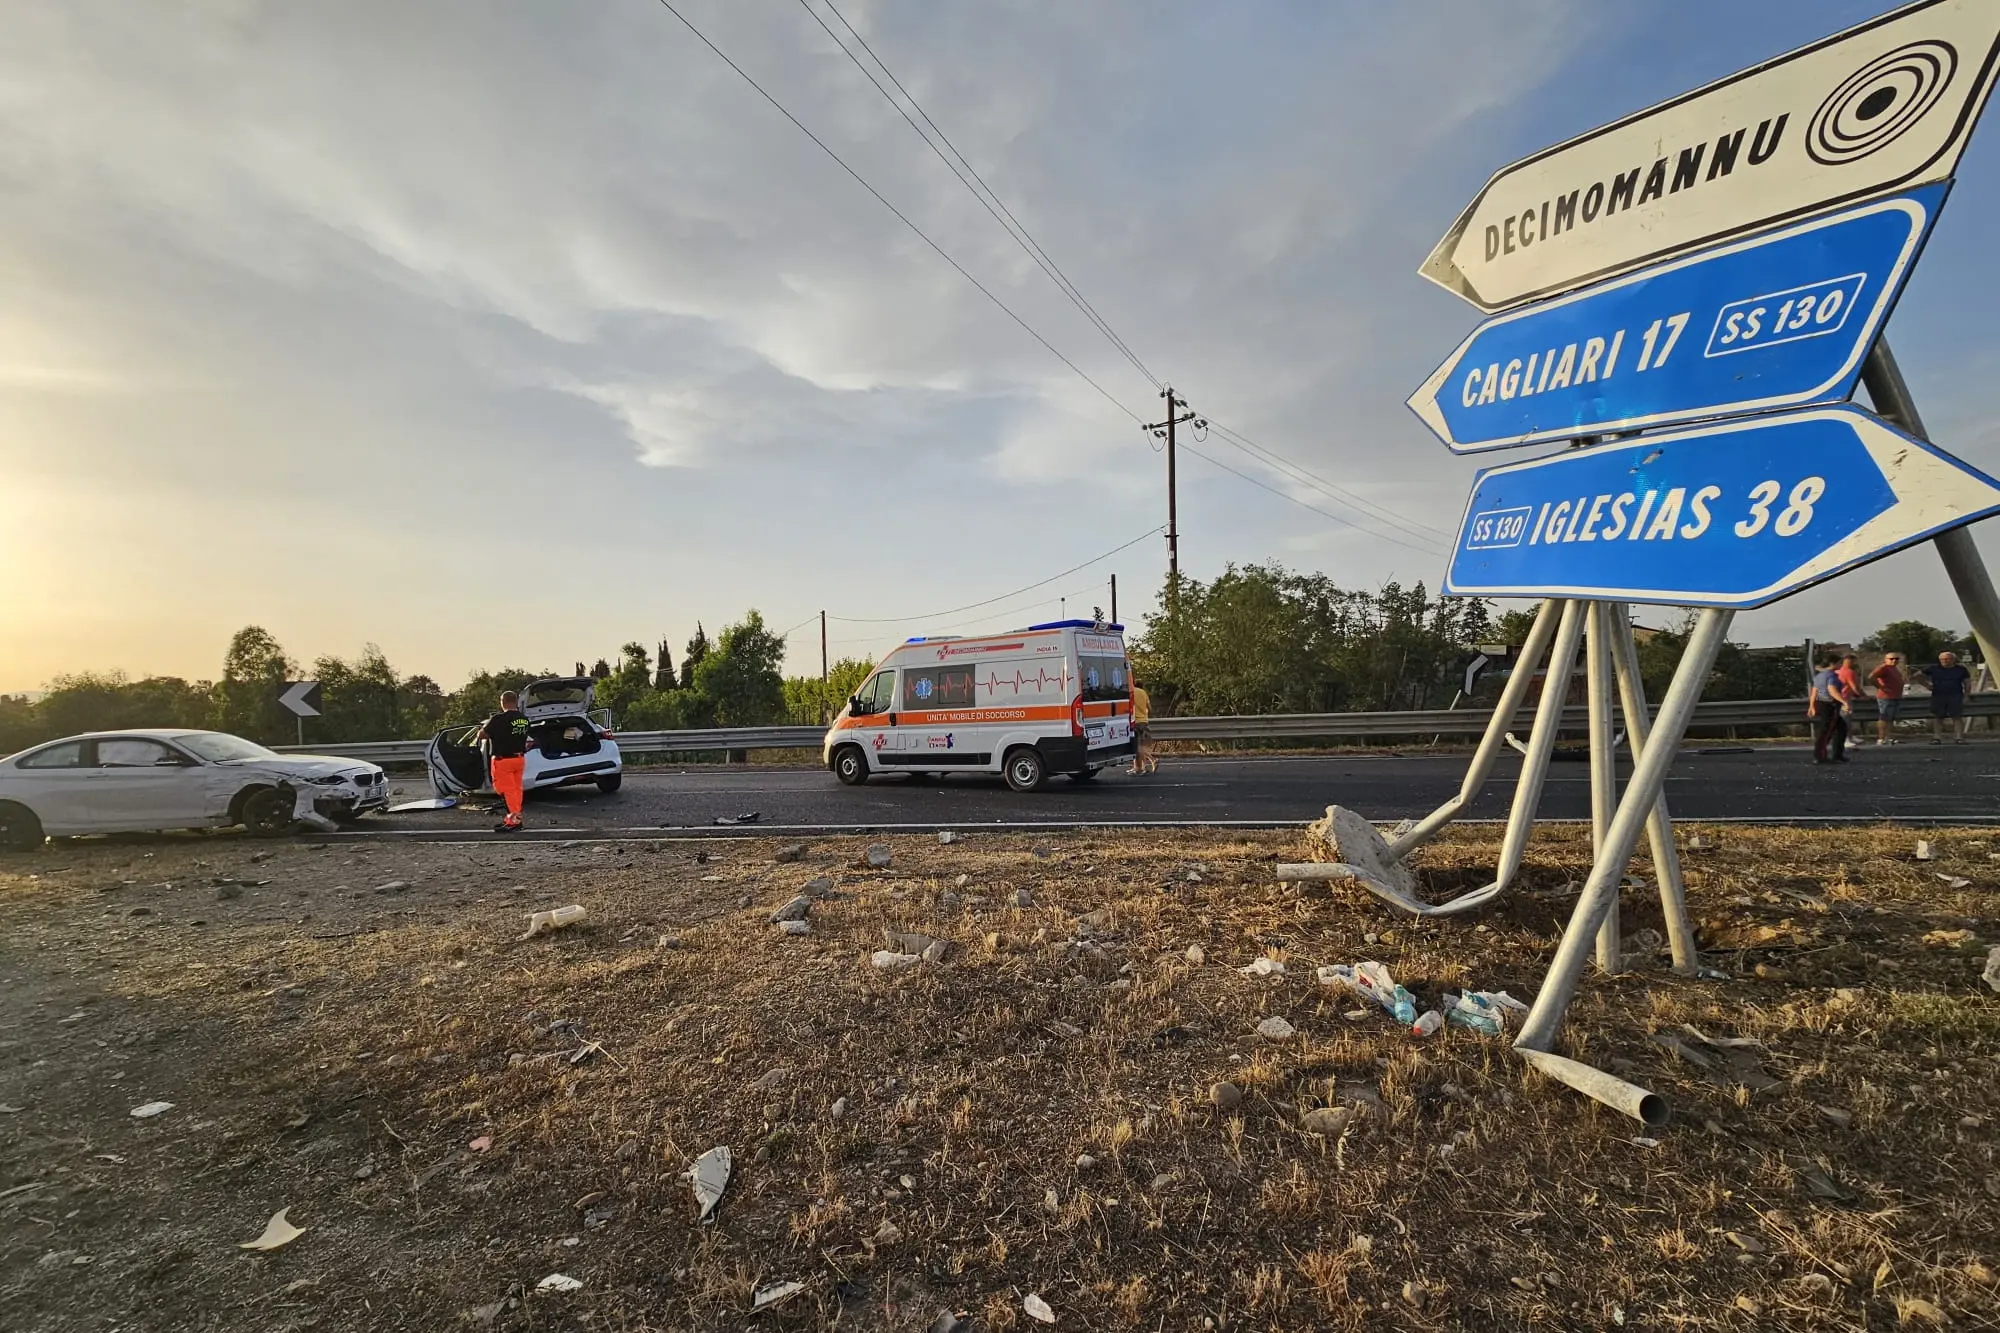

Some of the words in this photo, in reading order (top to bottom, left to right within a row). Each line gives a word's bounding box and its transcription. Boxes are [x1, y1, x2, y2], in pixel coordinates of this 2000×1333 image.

[1485, 112, 1790, 262] DECIMOMANNU
[1462, 329, 1625, 408] CAGLIARI
[1636, 312, 1691, 372] 17
[1721, 307, 1767, 344] SS
[1773, 289, 1844, 334] 130
[1474, 518, 1494, 542] SS
[1495, 515, 1523, 540] 130
[1529, 485, 1722, 545] IGLESIAS
[1734, 476, 1825, 538] 38
[949, 712, 976, 721] MOBILE
[976, 711, 984, 720] DI
[985, 710, 1026, 720] SOCCORSO
